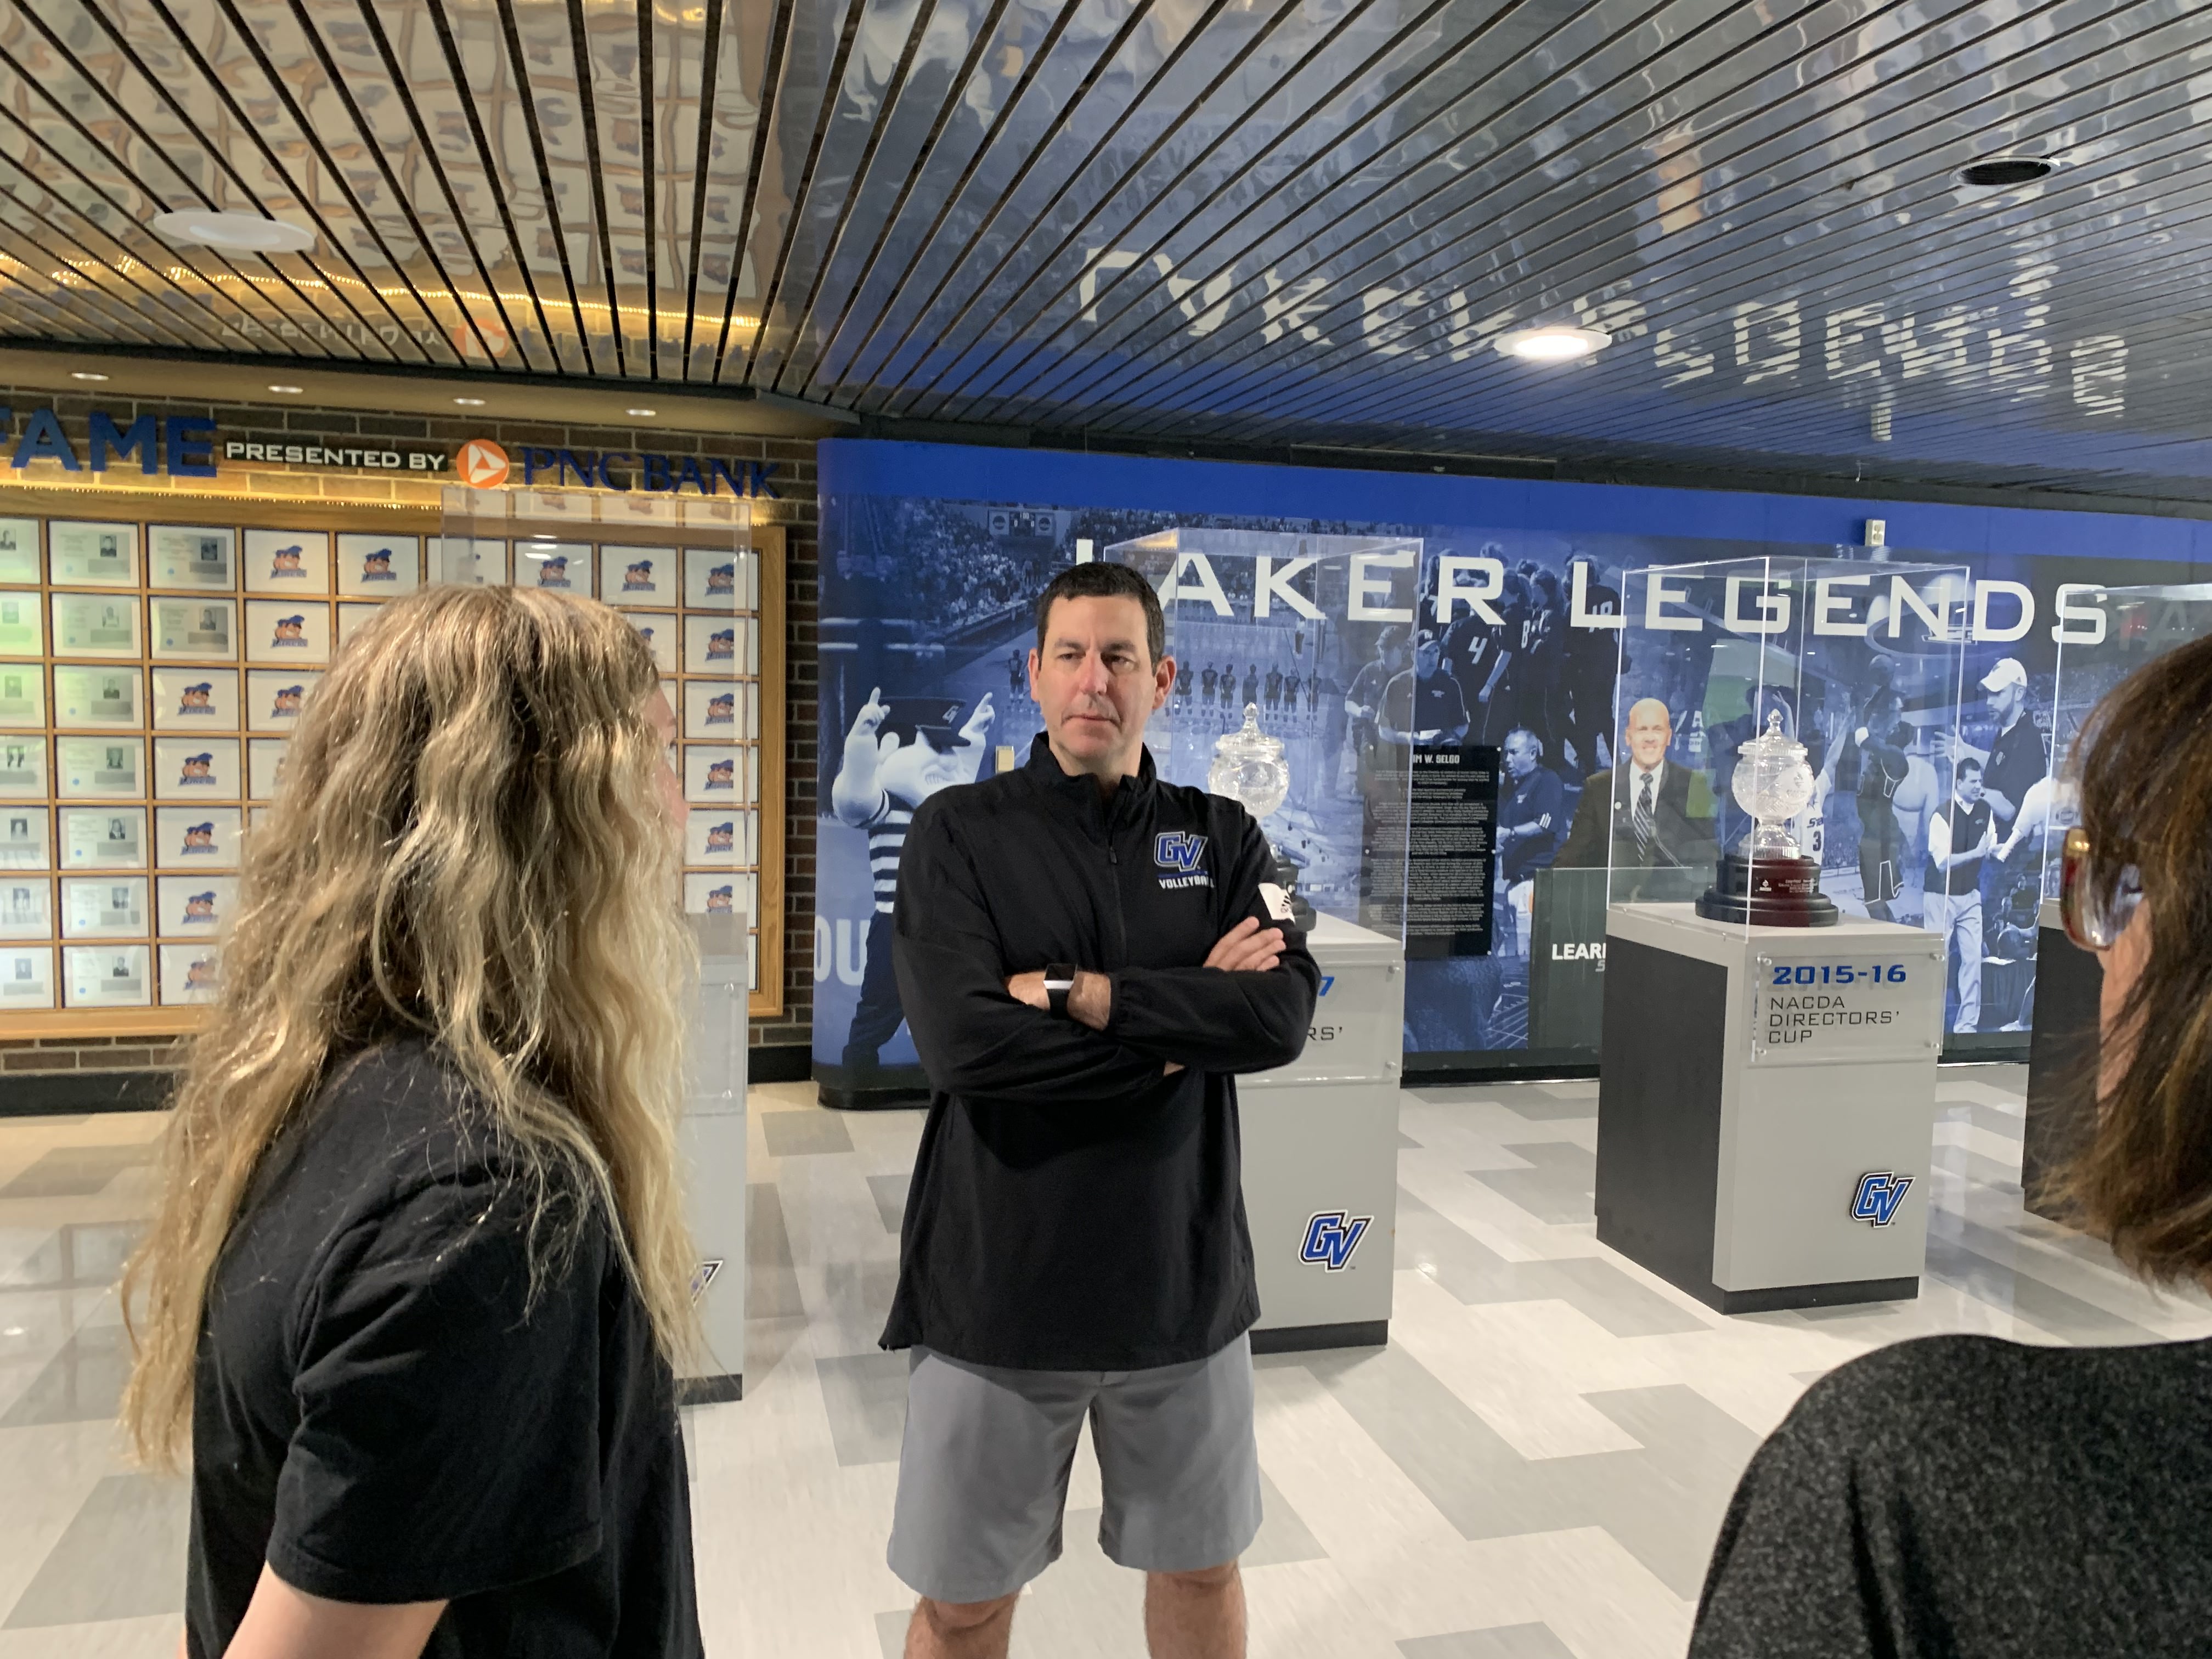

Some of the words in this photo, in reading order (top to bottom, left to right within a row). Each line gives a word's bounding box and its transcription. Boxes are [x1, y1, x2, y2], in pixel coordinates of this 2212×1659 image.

[226, 442, 401, 469] PRESENTED
[409, 453, 445, 471] BY
[519, 447, 633, 492] PNC
[639, 454, 781, 499] BANK
[1076, 539, 1506, 625] AKER
[1570, 561, 2108, 645] LEGENDS
[1468, 636, 1488, 664] 4
[1413, 754, 1423, 764] IM
[1424, 754, 1434, 764] W.
[1154, 831, 1208, 872] GV
[1813, 831, 1821, 851] 3
[1773, 964, 1906, 985] 2015-16
[1770, 996, 1845, 1011] NACDA
[1770, 1011, 1900, 1027] DIRECTORS'
[1769, 1030, 1812, 1043] CUP
[1852, 1172, 1916, 1228] GV
[1298, 1209, 1375, 1273] GV
